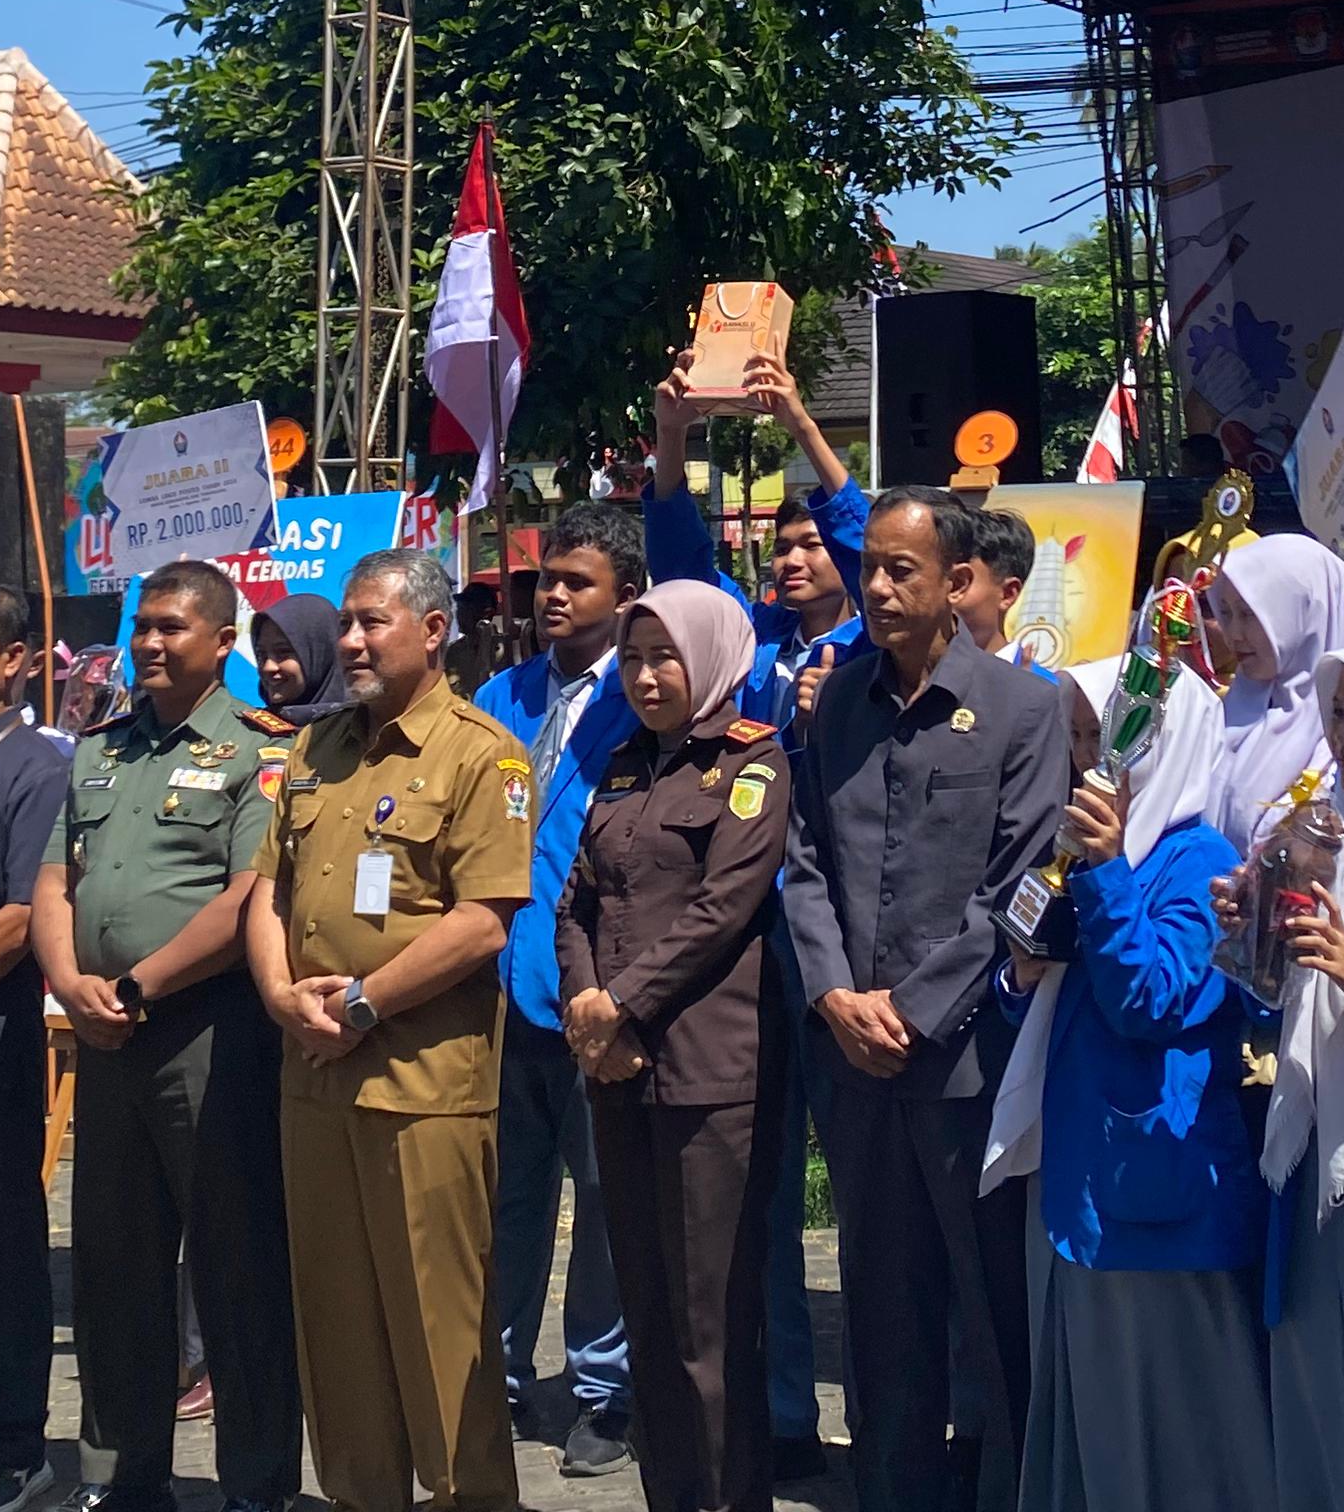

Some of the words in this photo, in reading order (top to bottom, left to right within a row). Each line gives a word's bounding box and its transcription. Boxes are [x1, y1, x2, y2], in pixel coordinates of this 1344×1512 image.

[270, 438, 294, 457] 44
[976, 433, 994, 454] 3
[144, 463, 209, 490] JUARA
[127, 522, 153, 547] RP.
[157, 502, 256, 541] 2.000.000,-
[245, 558, 325, 583] CERDAS
